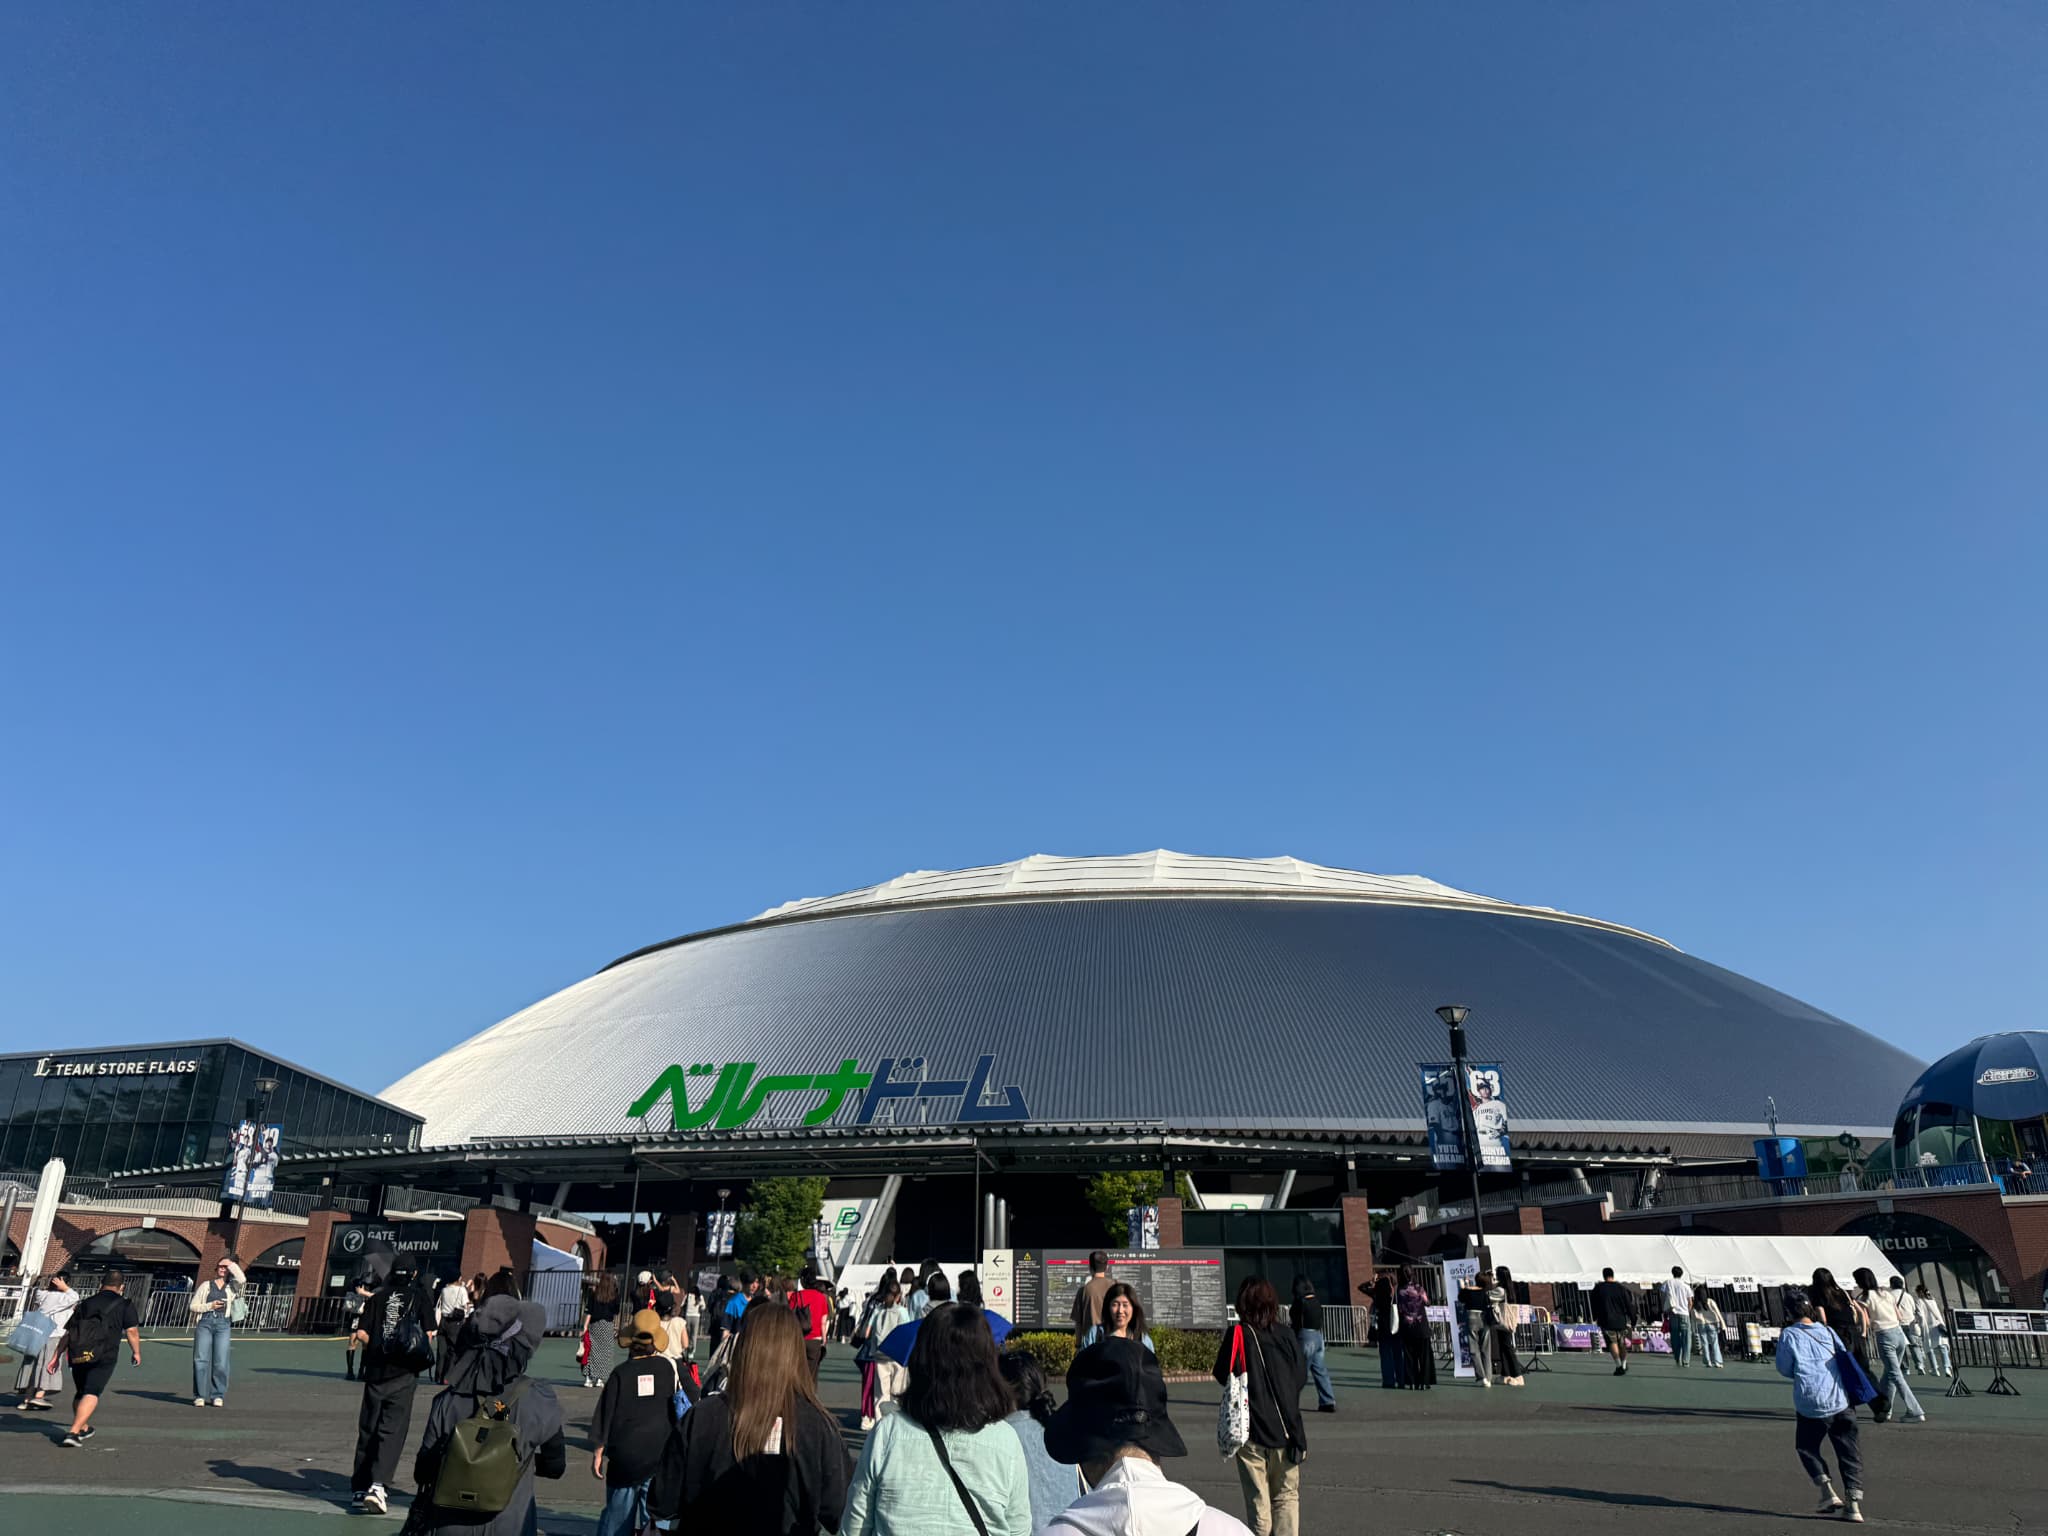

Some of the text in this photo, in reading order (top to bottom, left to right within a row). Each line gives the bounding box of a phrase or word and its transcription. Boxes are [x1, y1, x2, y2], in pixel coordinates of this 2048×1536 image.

[56, 1063, 94, 1076] TEAM
[97, 1062, 145, 1075] STORE
[148, 1060, 197, 1073] FLAGS
[1470, 1070, 1501, 1097] 63
[626, 1053, 1033, 1130] ベルーナドーム
[367, 1231, 396, 1241] GATE
[1873, 1237, 1928, 1251] NCLUB
[287, 1258, 302, 1267] TEA
